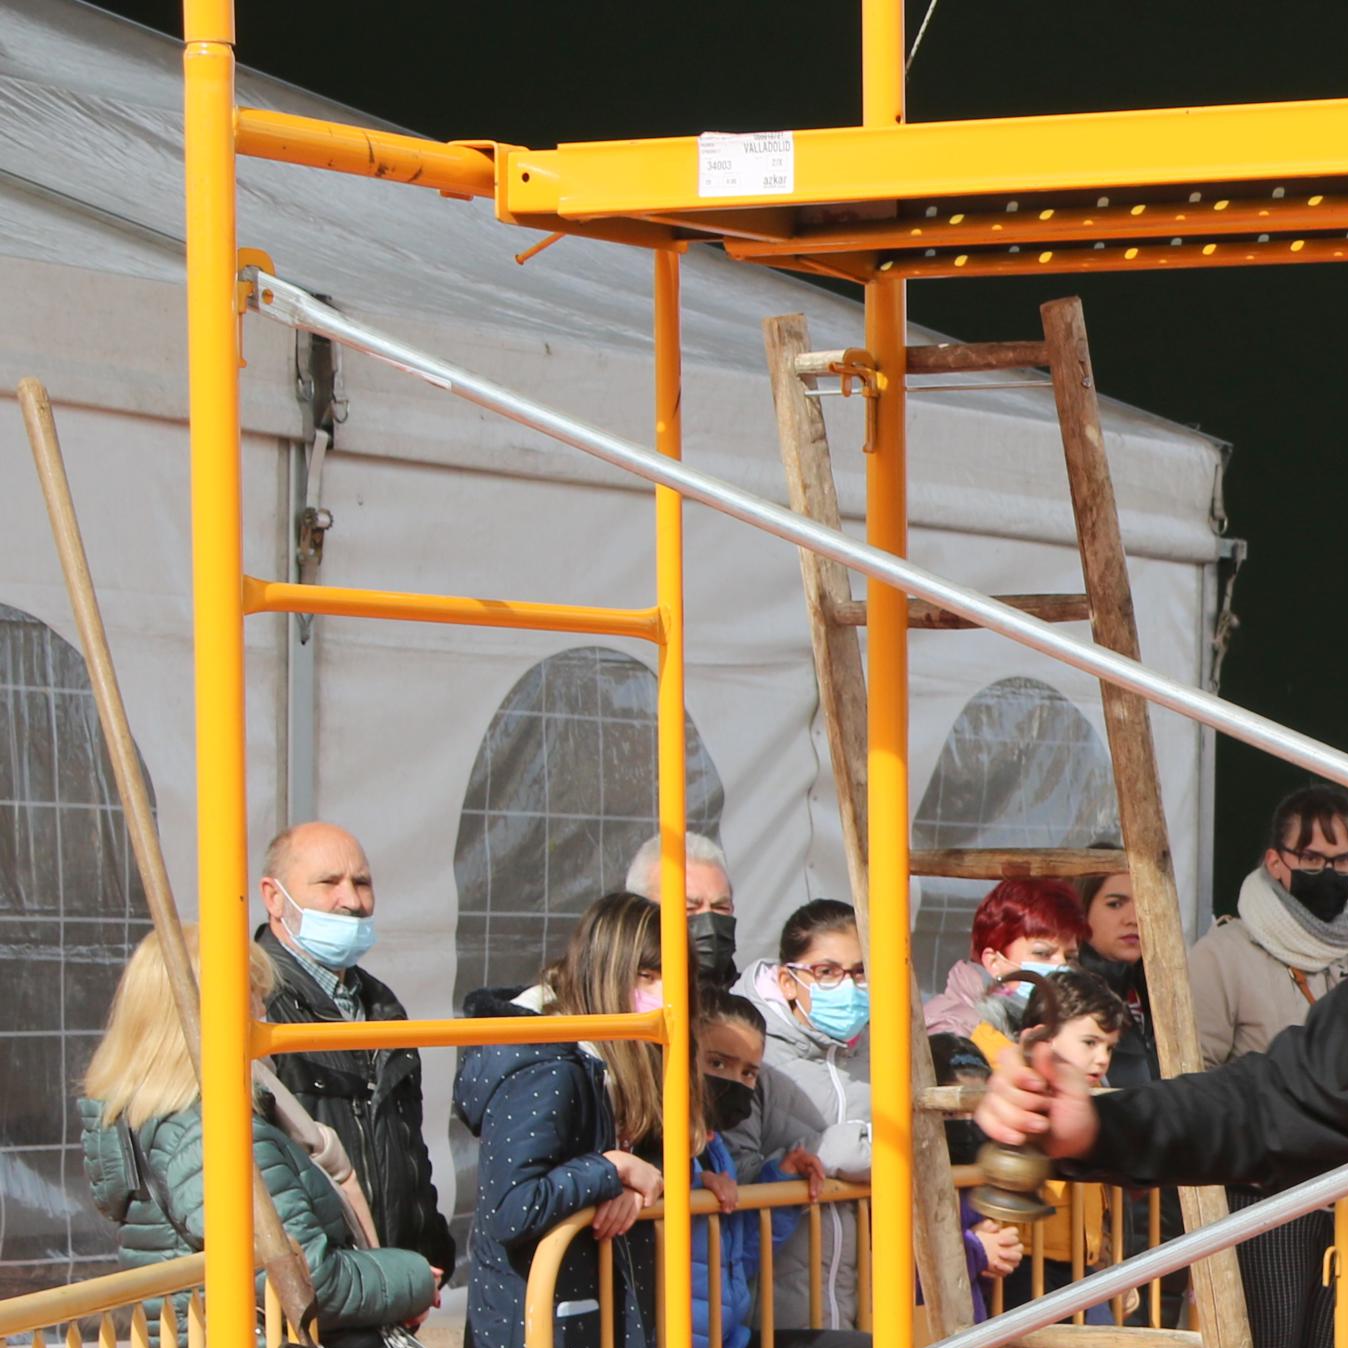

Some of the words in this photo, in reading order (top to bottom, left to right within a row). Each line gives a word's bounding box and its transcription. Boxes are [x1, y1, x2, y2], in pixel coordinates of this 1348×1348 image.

[744, 140, 791, 153] VALLADOLID
[707, 160, 732, 170] 34003
[763, 174, 787, 185] azkar
